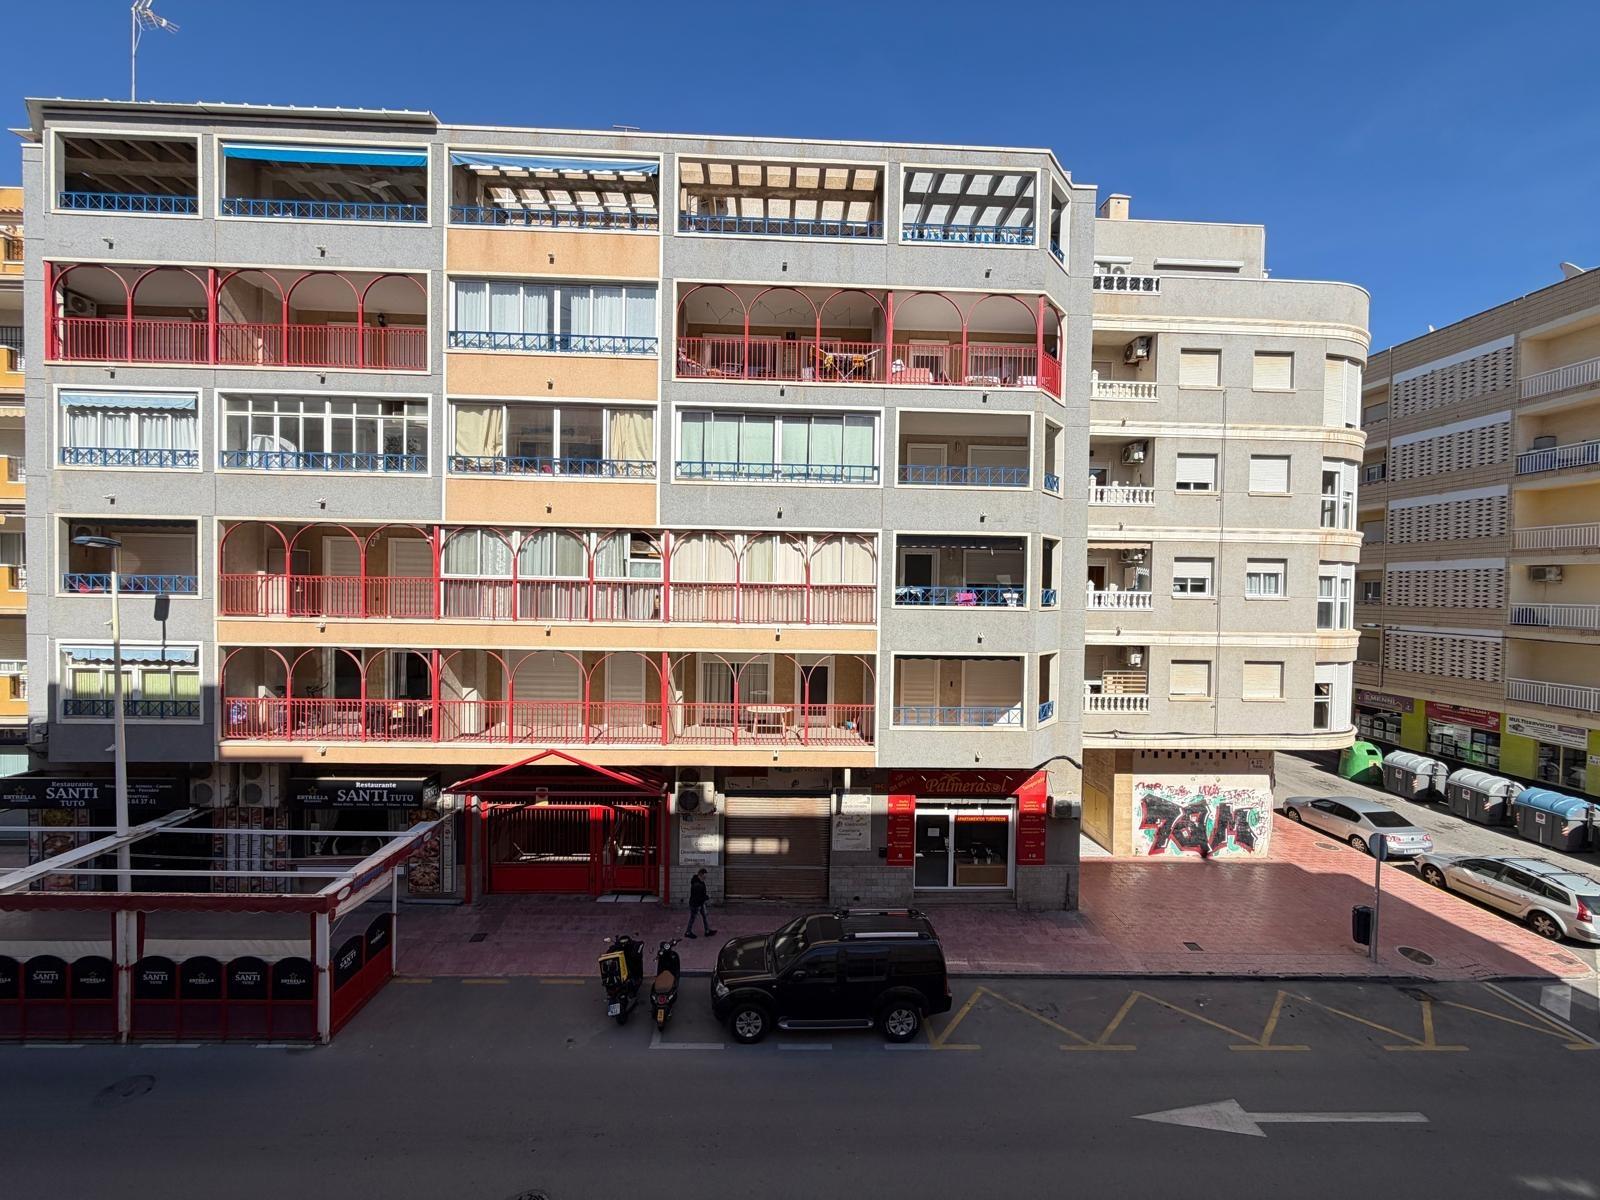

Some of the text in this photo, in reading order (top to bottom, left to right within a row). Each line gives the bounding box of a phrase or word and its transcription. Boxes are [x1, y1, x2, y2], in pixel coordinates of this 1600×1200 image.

[1508, 716, 1556, 730] MULTISERVICIOS
[45, 787, 99, 800] SANTI
[336, 789, 388, 802] SANTI
[389, 794, 414, 802] TUTO
[61, 799, 86, 807] TUTO
